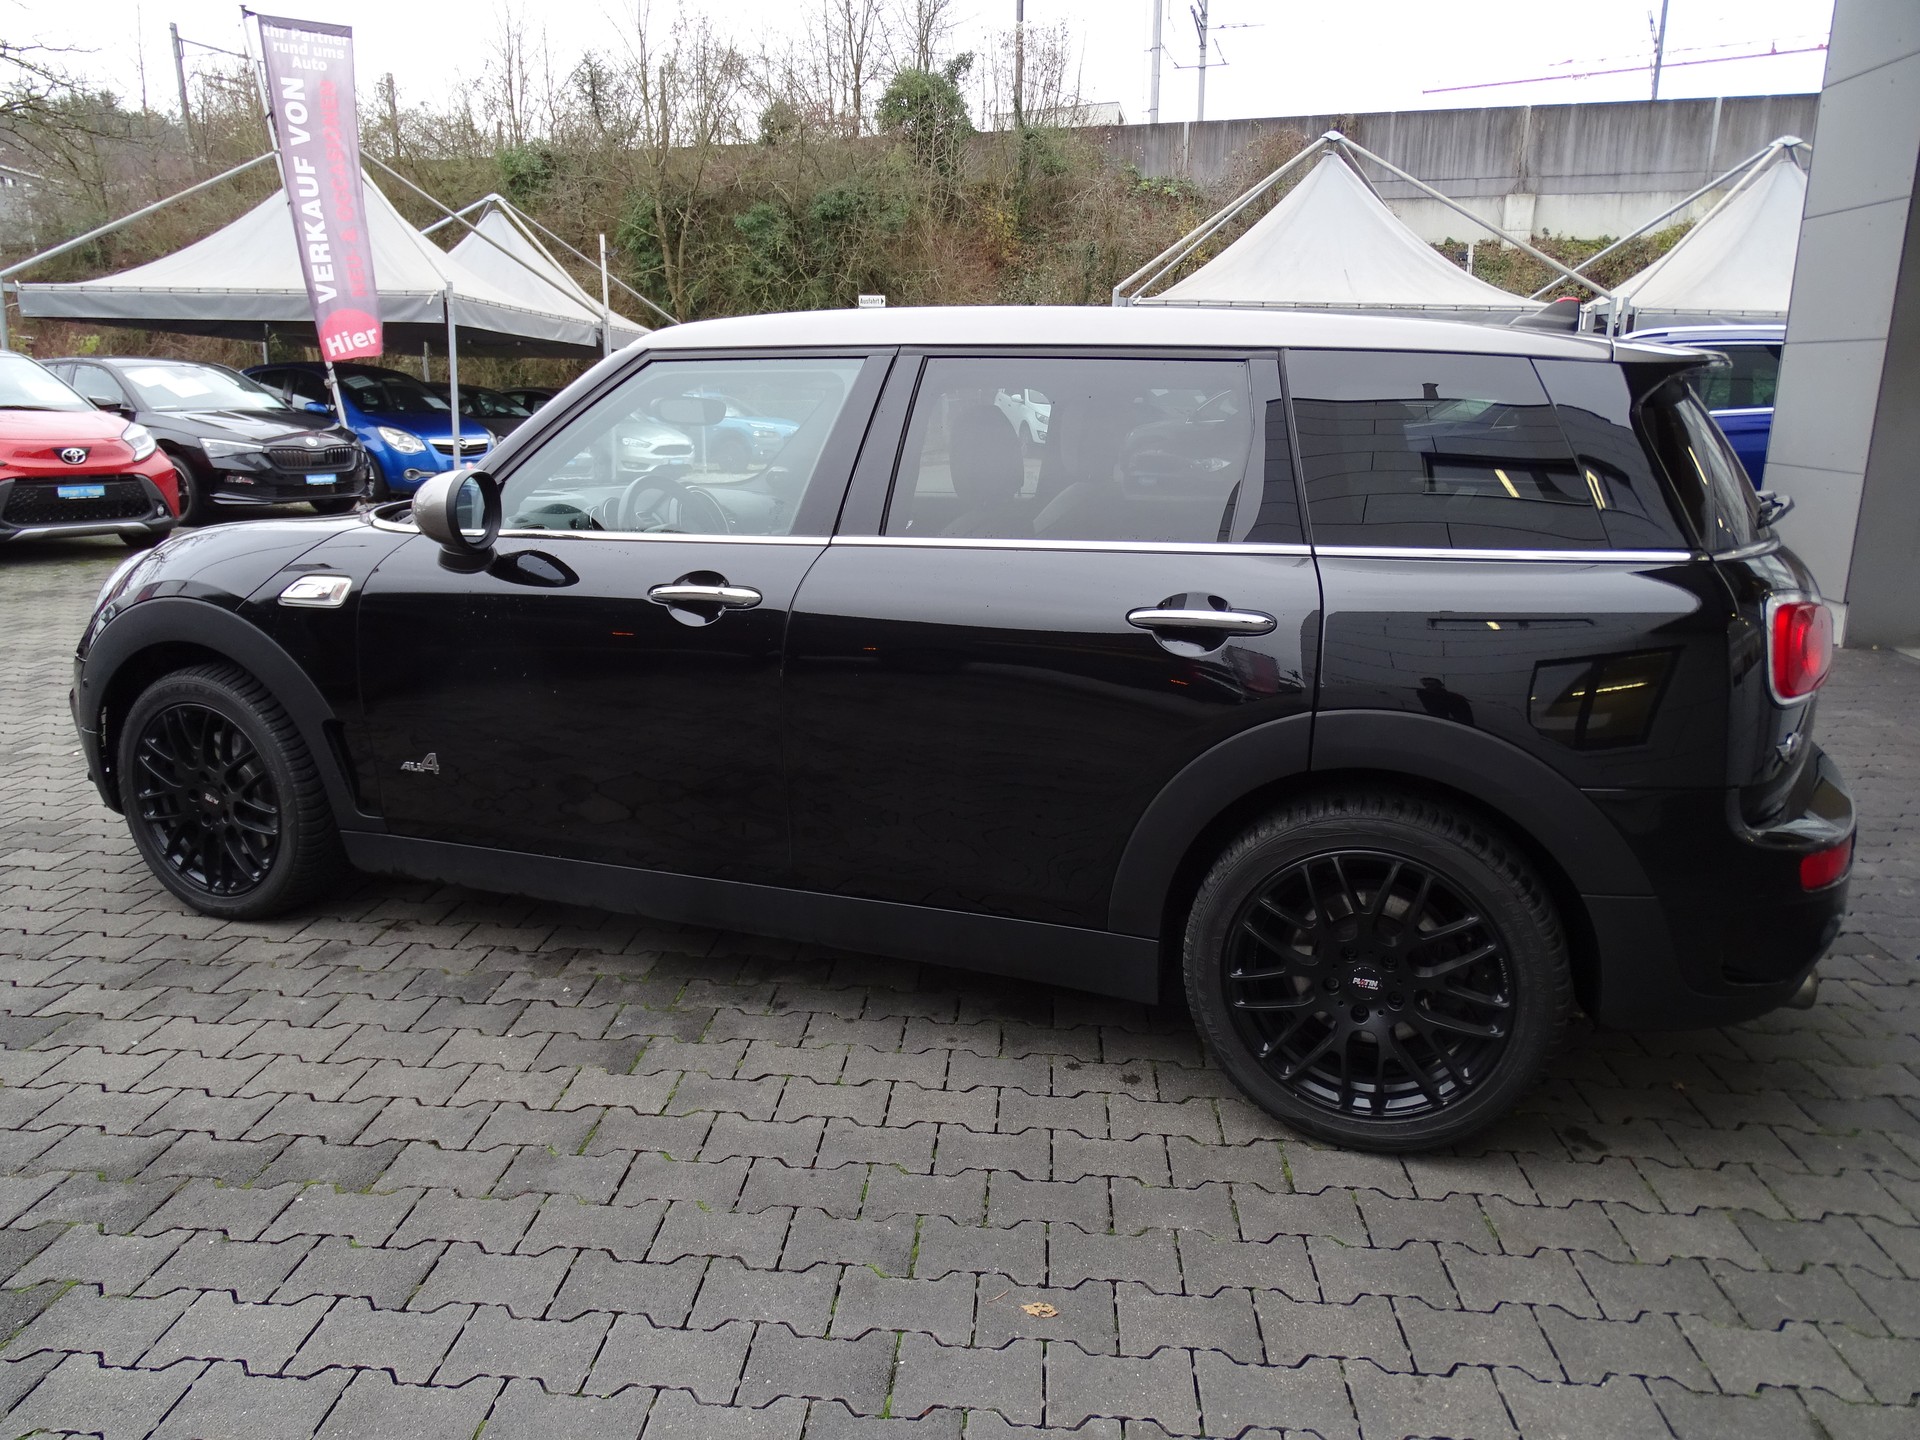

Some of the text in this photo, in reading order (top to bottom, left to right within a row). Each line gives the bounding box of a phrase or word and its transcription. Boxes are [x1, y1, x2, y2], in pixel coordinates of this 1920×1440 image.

[291, 28, 347, 46] Partner
[273, 41, 345, 60] rund ums
[292, 55, 328, 71] Auto
[280, 77, 338, 304] VERKAUF VON
[325, 327, 377, 357] Hier
